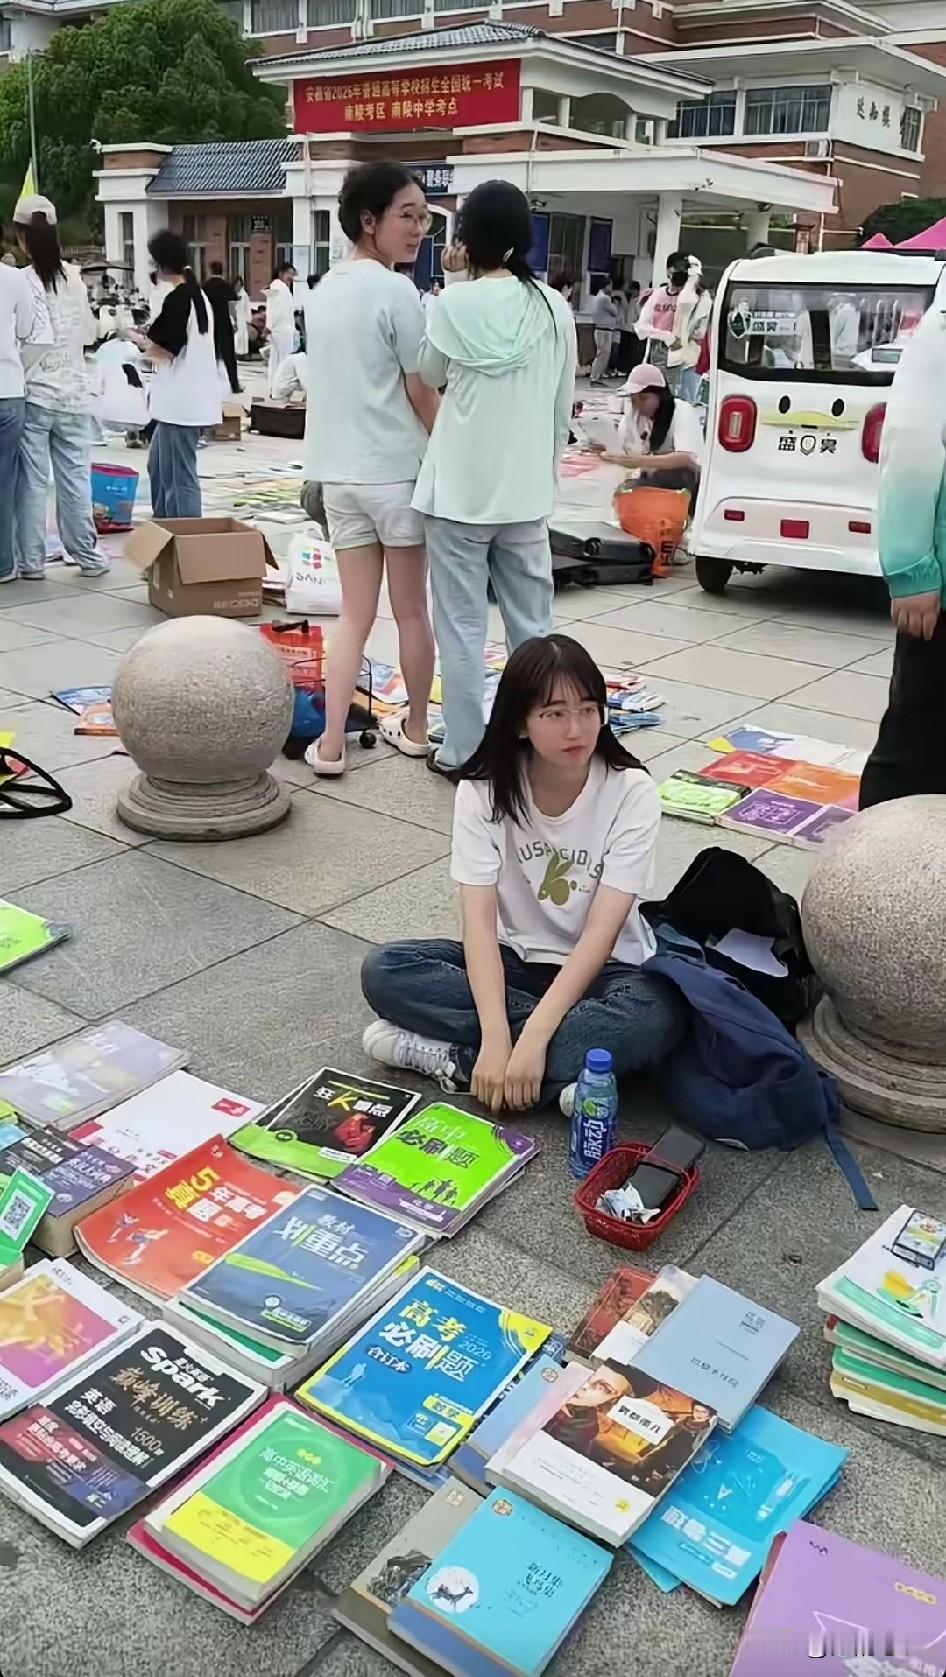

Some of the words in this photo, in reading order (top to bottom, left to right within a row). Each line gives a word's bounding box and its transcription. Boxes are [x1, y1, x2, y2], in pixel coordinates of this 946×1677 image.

[345, 103, 385, 121] 南陵考区
[392, 98, 457, 119] 南陵中学考点
[397, 1128, 481, 1168] 必刷题
[583, 1120, 605, 1160] 脉动
[272, 1215, 368, 1265] 划重点
[398, 1298, 467, 1341] 高考
[367, 1347, 410, 1372] 合订本
[377, 1320, 479, 1382] 必刷题
[139, 1346, 225, 1407] Spark
[79, 1387, 117, 1415] 英语
[108, 1365, 199, 1431] 巅峰训练
